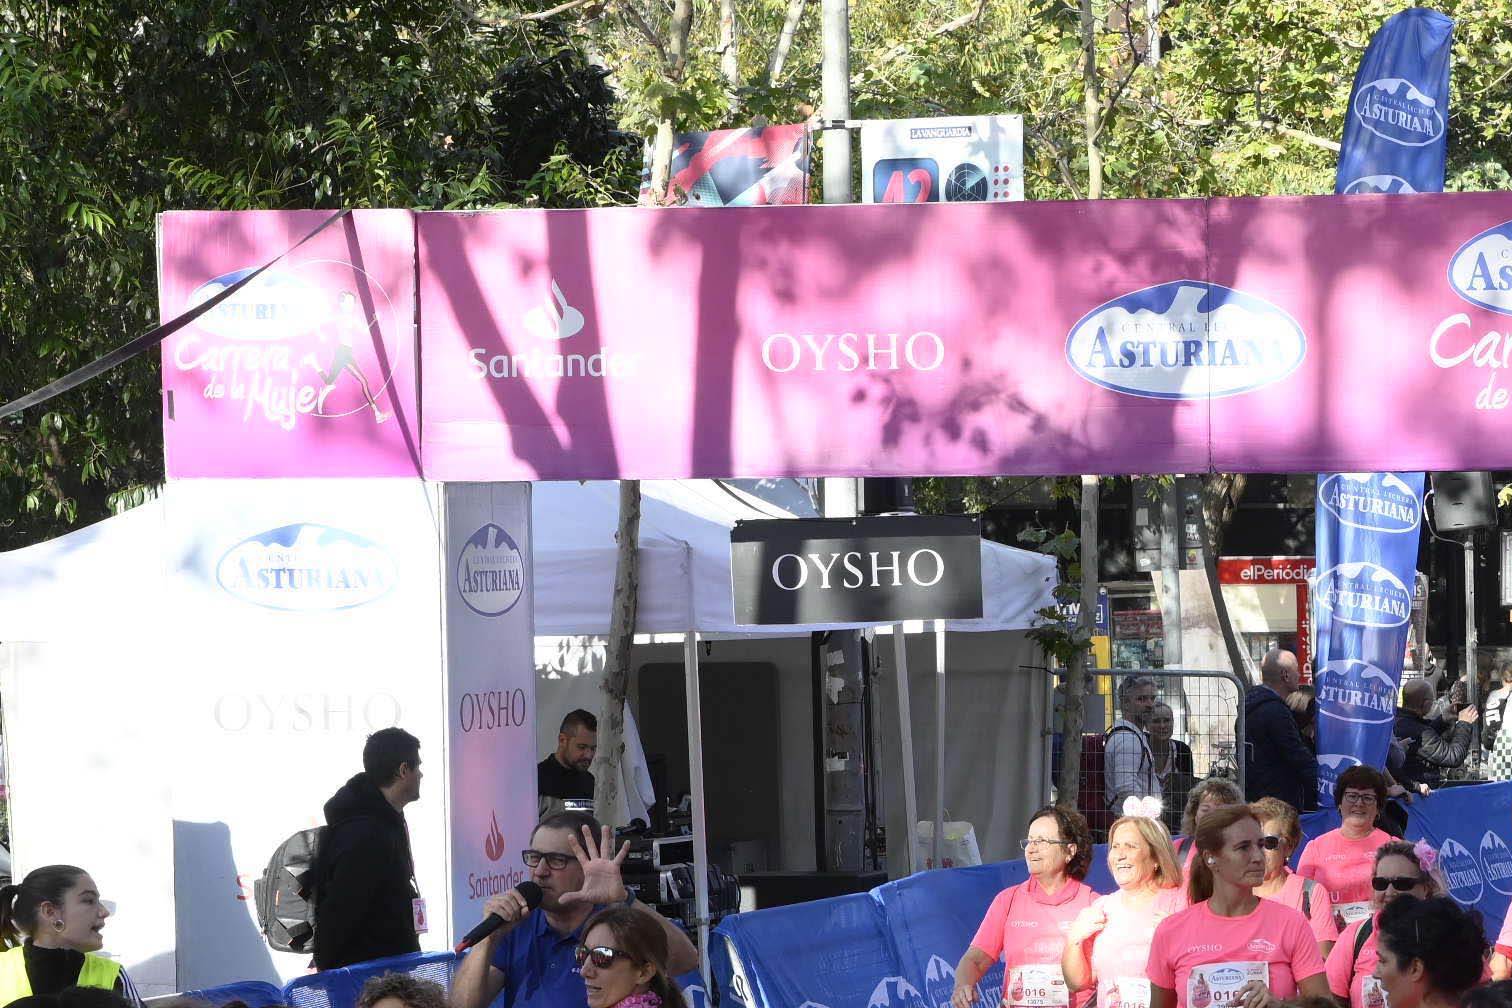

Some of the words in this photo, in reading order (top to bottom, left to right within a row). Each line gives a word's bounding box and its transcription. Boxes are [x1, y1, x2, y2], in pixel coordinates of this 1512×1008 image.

[922, 126, 971, 138] VANGUARDIA
[761, 331, 945, 374] OYSHO
[1085, 325, 1288, 369] ASTURIANA
[1475, 371, 1509, 410] de
[1329, 482, 1415, 525] ASTURIANA
[233, 556, 384, 590] ASTURIANA
[463, 558, 521, 594] ASTURIANA
[771, 549, 946, 591] OYSHO
[213, 690, 403, 733] OYSHO
[460, 687, 527, 733] OYSHO
[468, 870, 525, 901] Santander
[1025, 987, 1047, 998] 016
